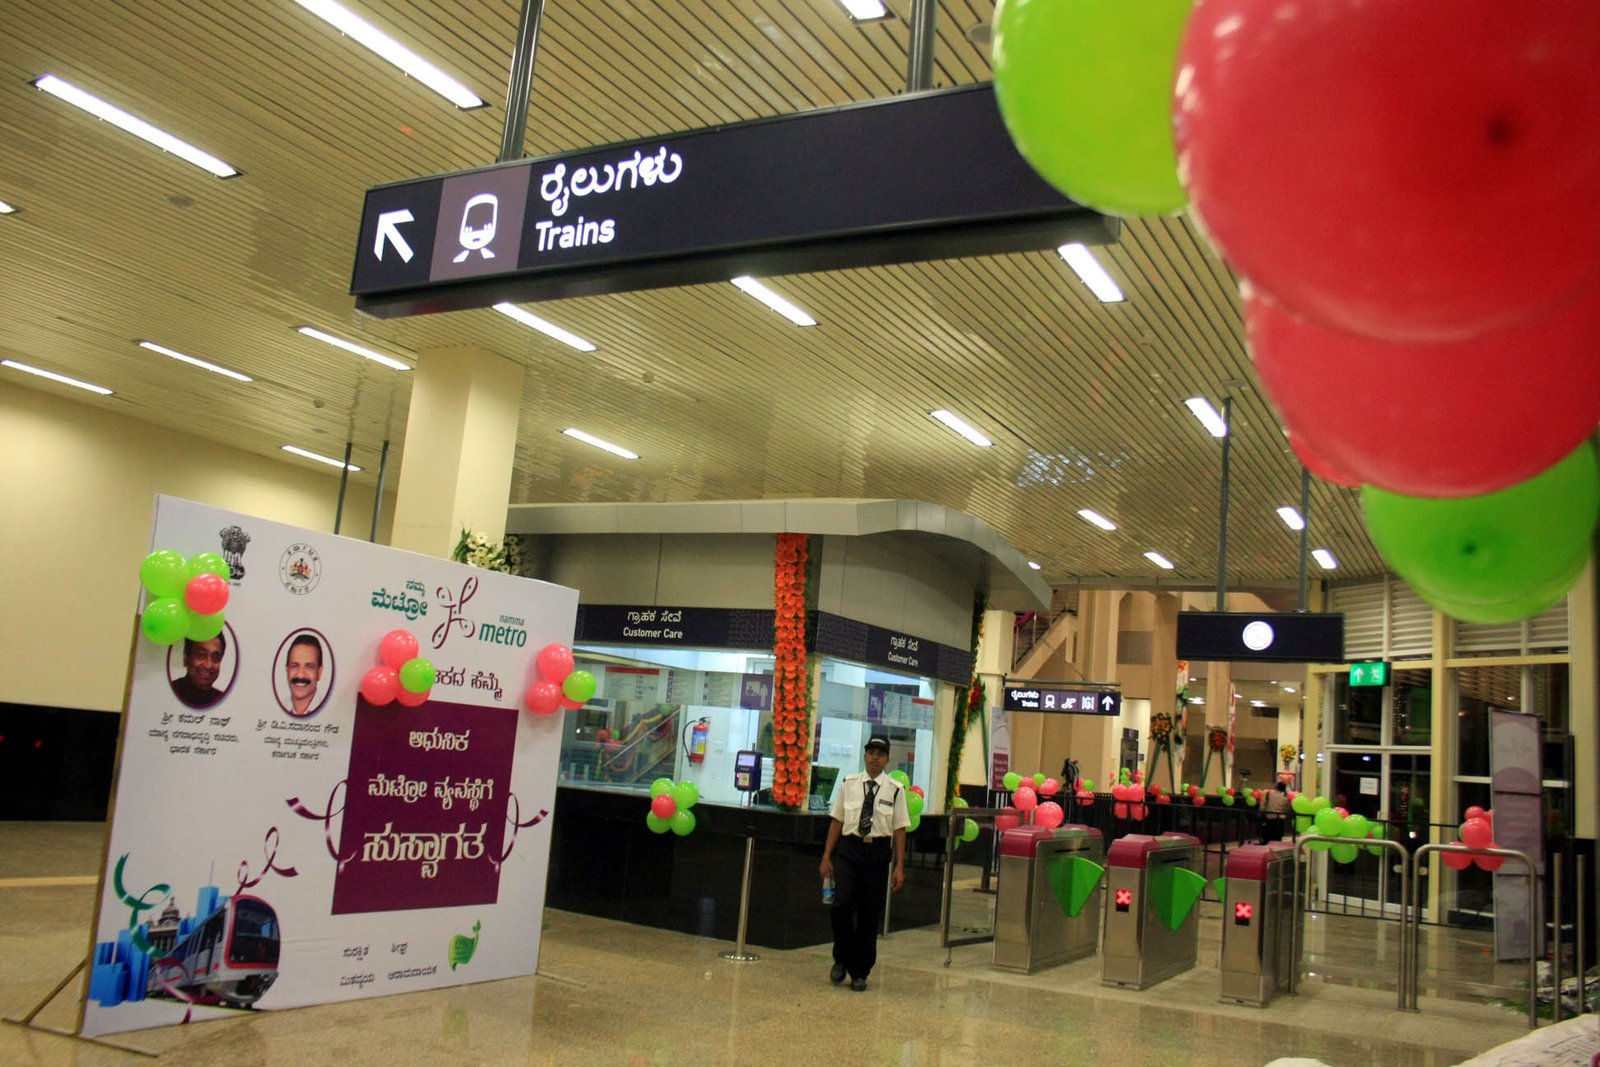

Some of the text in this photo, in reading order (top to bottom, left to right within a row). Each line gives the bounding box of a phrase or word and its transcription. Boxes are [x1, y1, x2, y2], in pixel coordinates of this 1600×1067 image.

[540, 145, 684, 217] ರೈಲುಗಳು
[535, 217, 616, 252] Trains
[405, 580, 426, 598] ನಮ್ಮ
[371, 588, 429, 621] ಮೆಟ್ರೋ
[627, 609, 683, 625] ಗ್ರಾಹಕ ಸೇವೆ
[499, 614, 525, 626] namma
[622, 626, 683, 640] Customer Care
[479, 623, 528, 648] metro
[470, 671, 503, 702] ಹೆಮ್ಮೆ
[408, 726, 472, 752] ಆಧುನಿಕ
[368, 773, 494, 812] ಮೆಟ್ರೋ ವ್ಯವಸ್ಥೆಗೆ
[361, 822, 488, 879] ಸುಸ್ವಾಗತ
